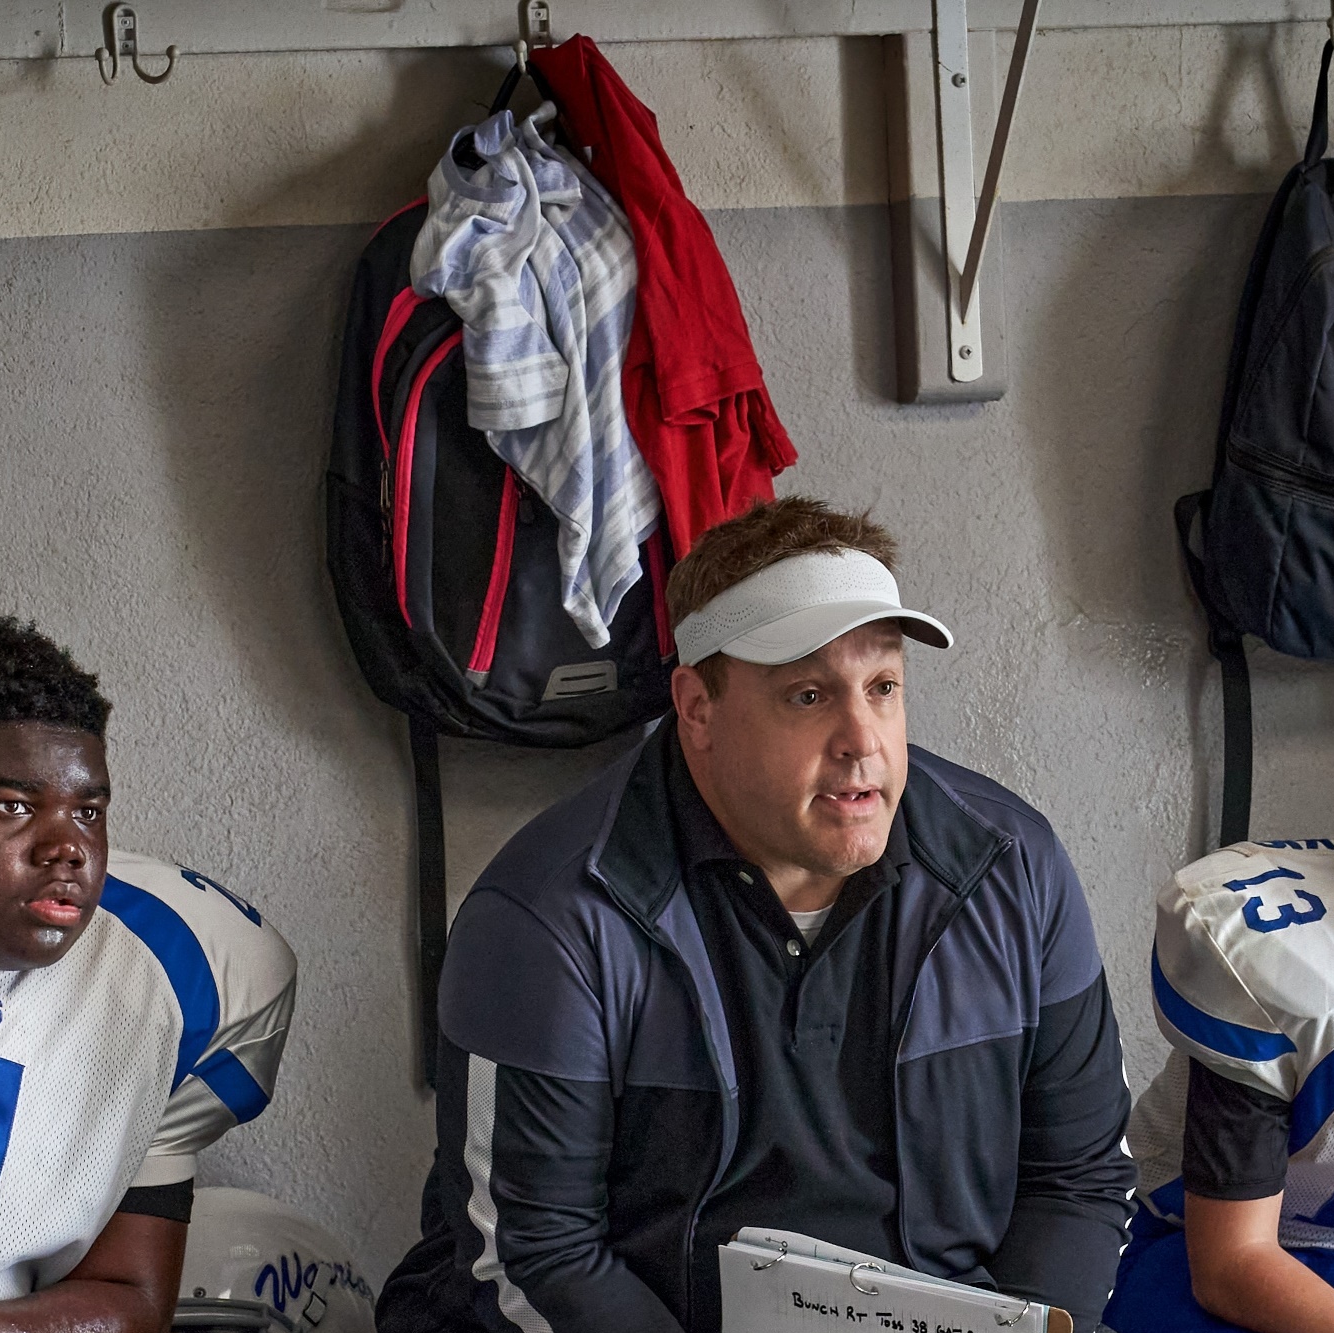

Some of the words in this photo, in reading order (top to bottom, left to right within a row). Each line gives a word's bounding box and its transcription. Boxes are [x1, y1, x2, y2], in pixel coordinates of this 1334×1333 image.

[1222, 866, 1327, 933] 13
[792, 1292, 839, 1317] BUNCH
[846, 1306, 868, 1322] RT
[876, 1312, 904, 1331] TOSS
